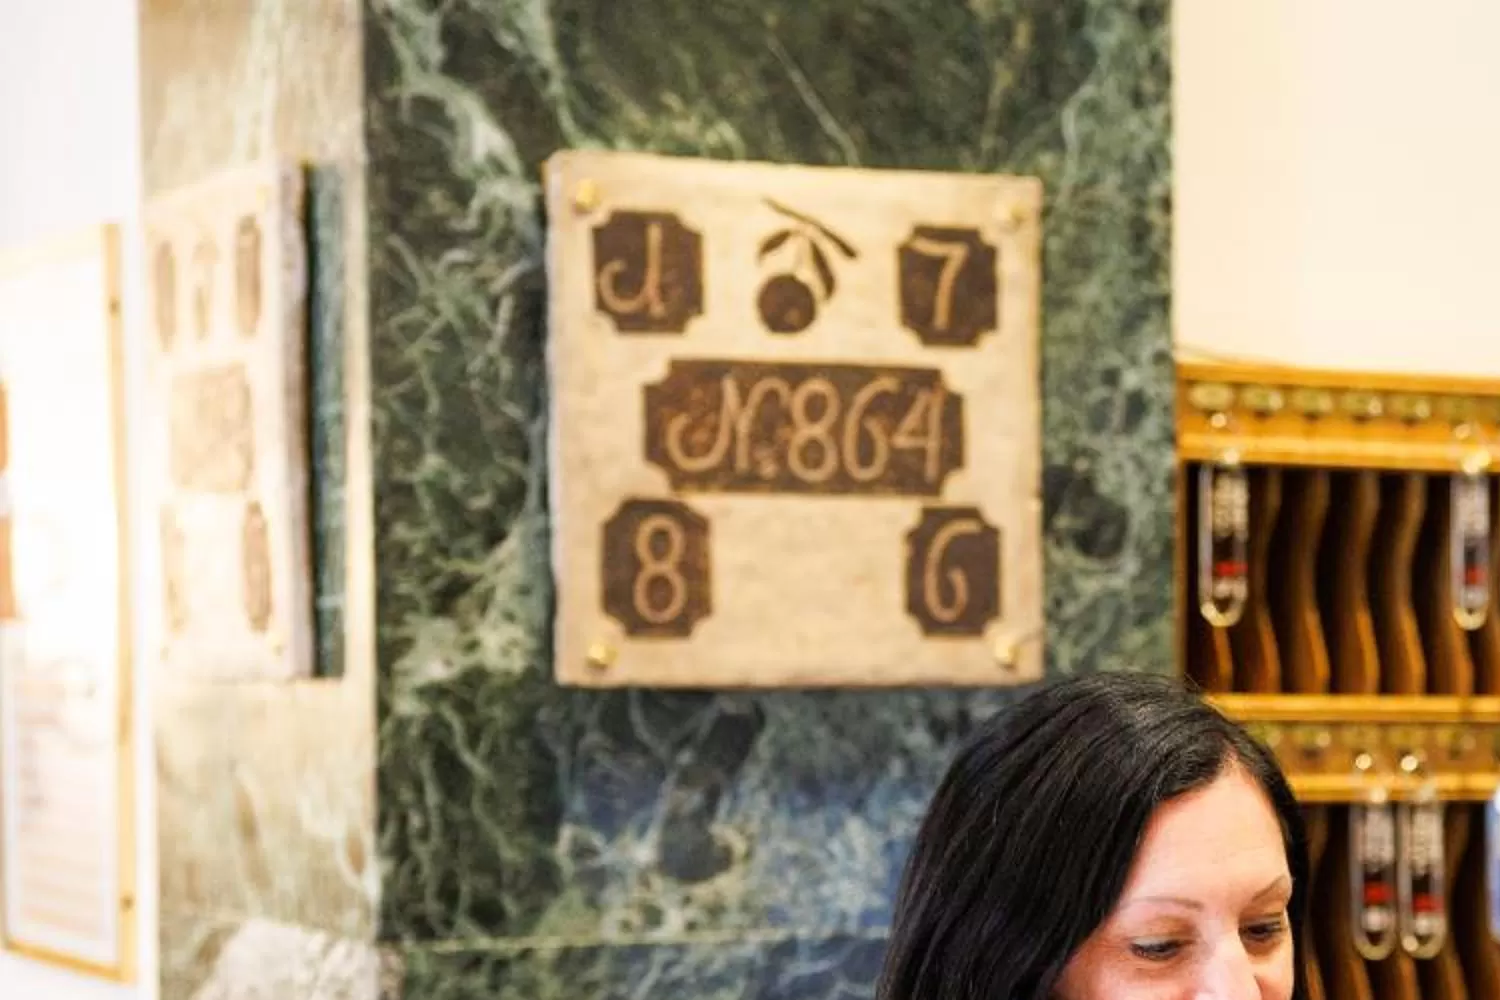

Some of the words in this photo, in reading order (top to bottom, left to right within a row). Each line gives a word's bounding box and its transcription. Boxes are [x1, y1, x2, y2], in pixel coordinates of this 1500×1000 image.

[908, 236, 969, 330] 7
[633, 513, 688, 624] 8
[926, 520, 984, 622] 6
